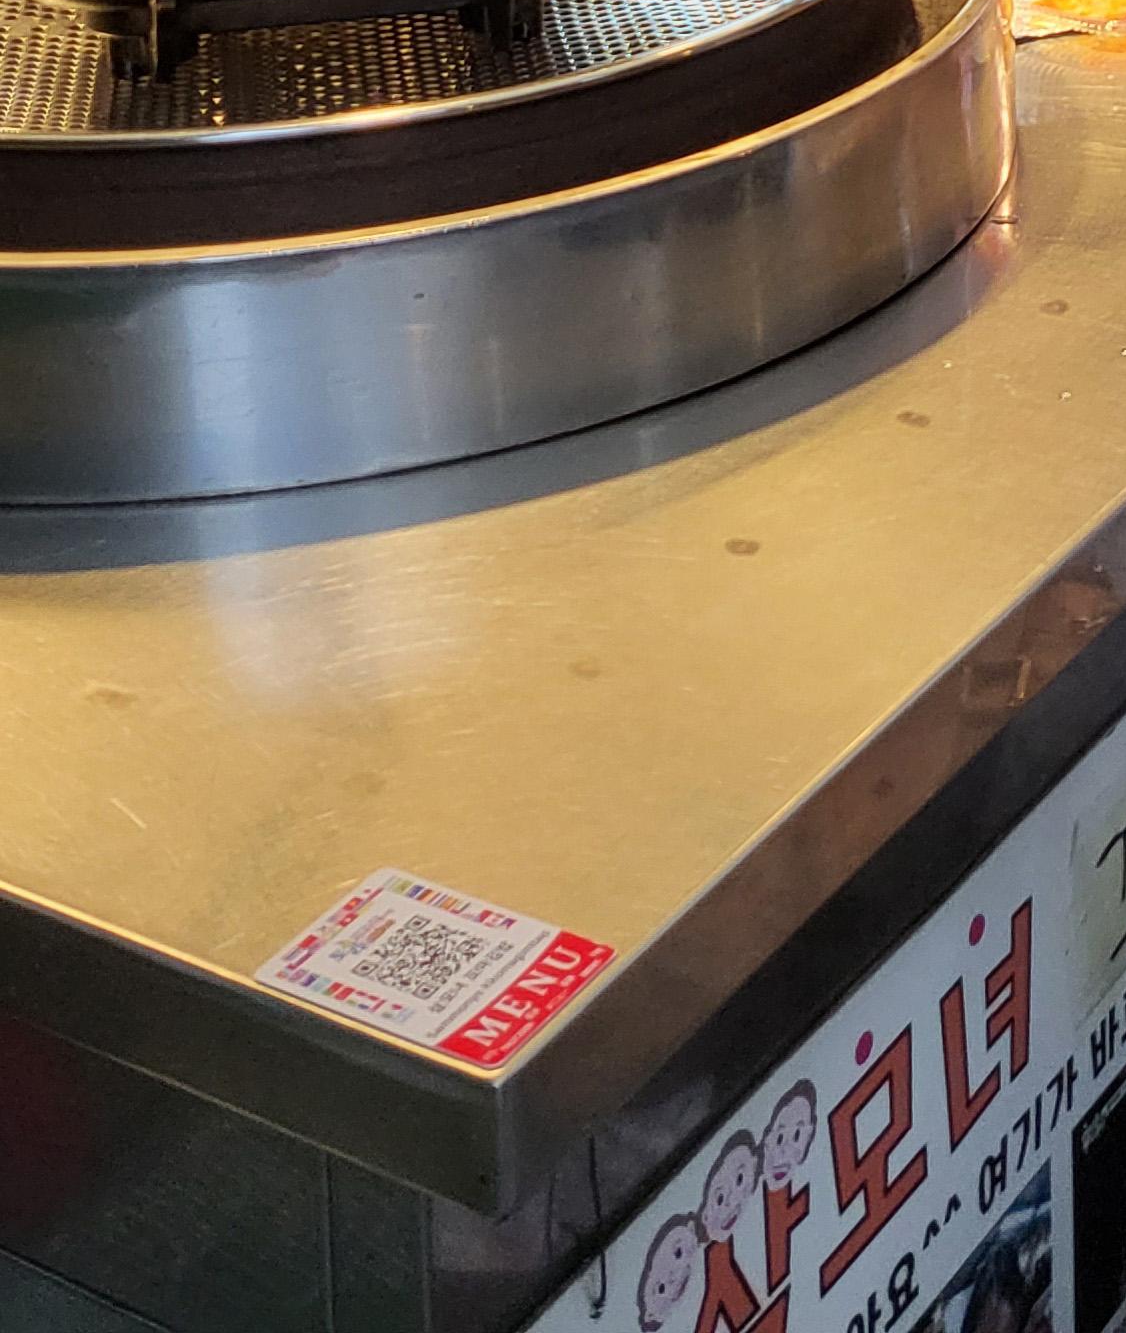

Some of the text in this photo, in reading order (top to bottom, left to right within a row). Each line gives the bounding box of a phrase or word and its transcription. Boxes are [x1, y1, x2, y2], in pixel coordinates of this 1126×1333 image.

[463, 944, 583, 1048] MENU
[691, 896, 1033, 1333] 삼모녀
[978, 1054, 1079, 1216] 여기가
